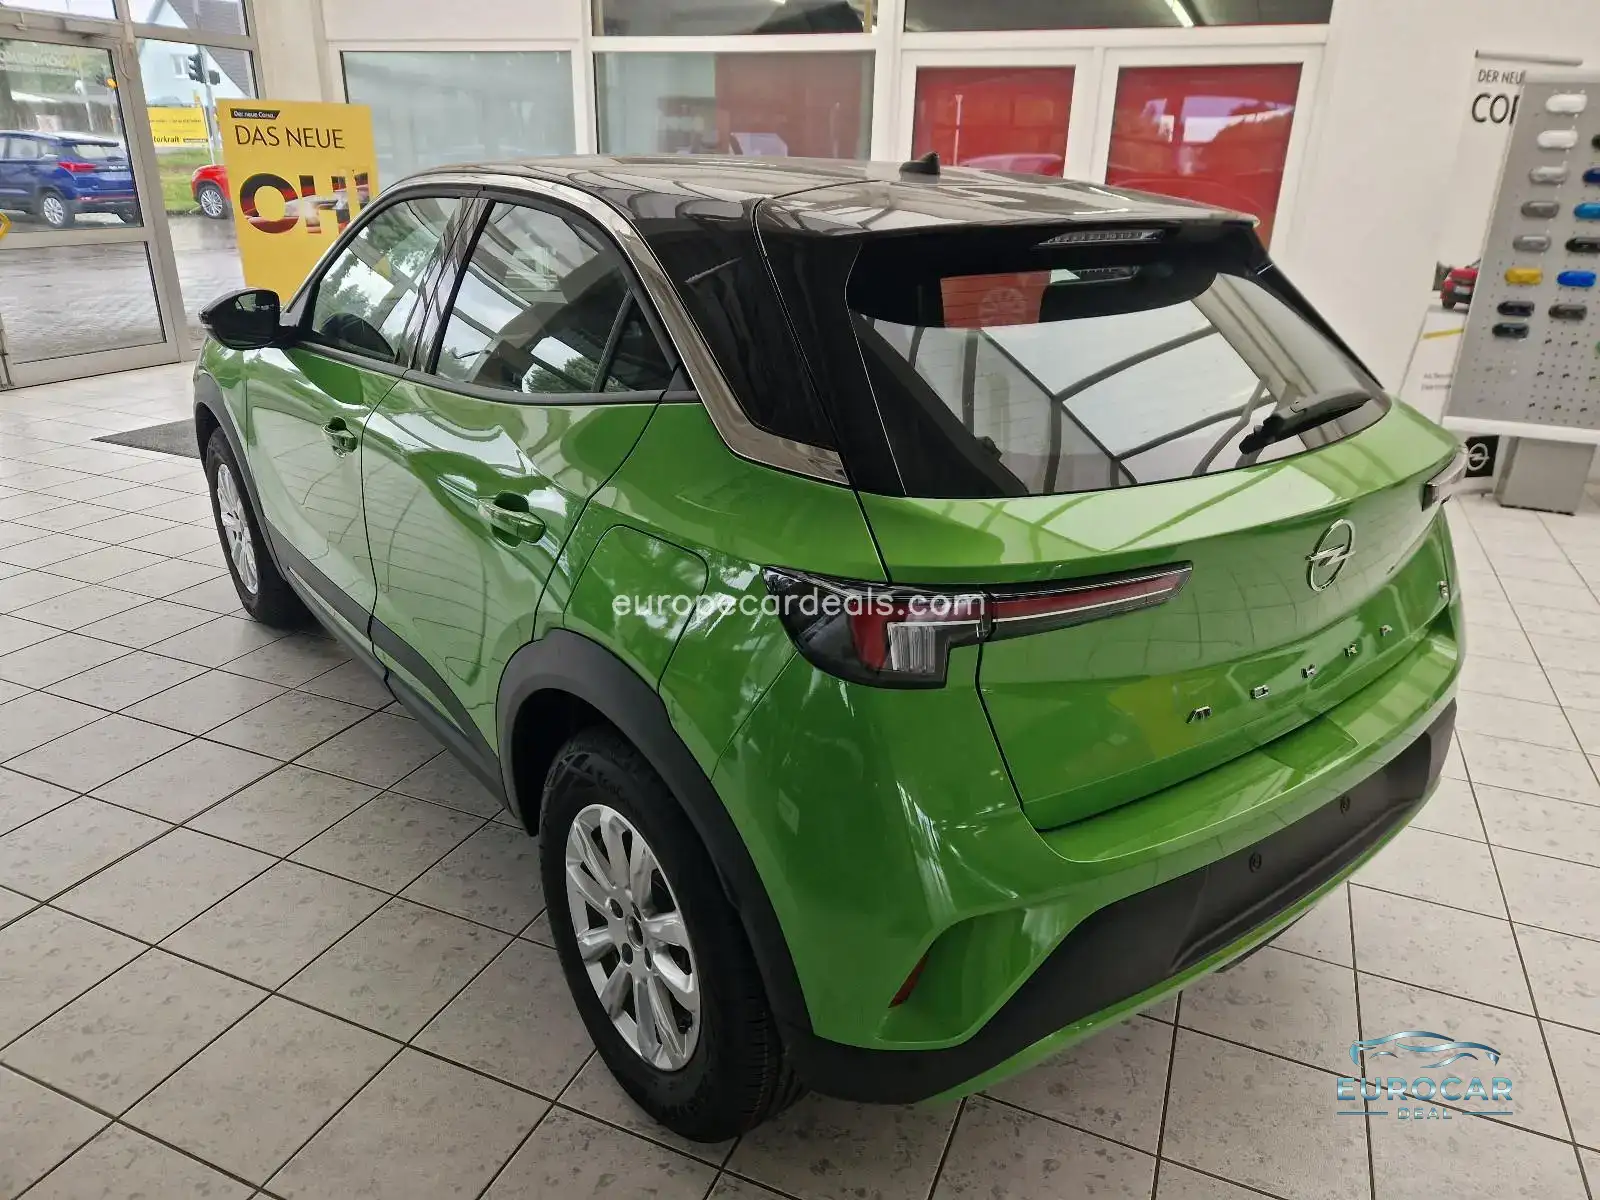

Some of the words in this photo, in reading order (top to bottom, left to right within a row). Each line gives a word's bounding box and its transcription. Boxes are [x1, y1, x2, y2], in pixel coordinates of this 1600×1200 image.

[1478, 69, 1499, 83] DER
[233, 110, 244, 118] Der
[235, 125, 280, 147] DAS
[285, 128, 346, 149] NEUE
